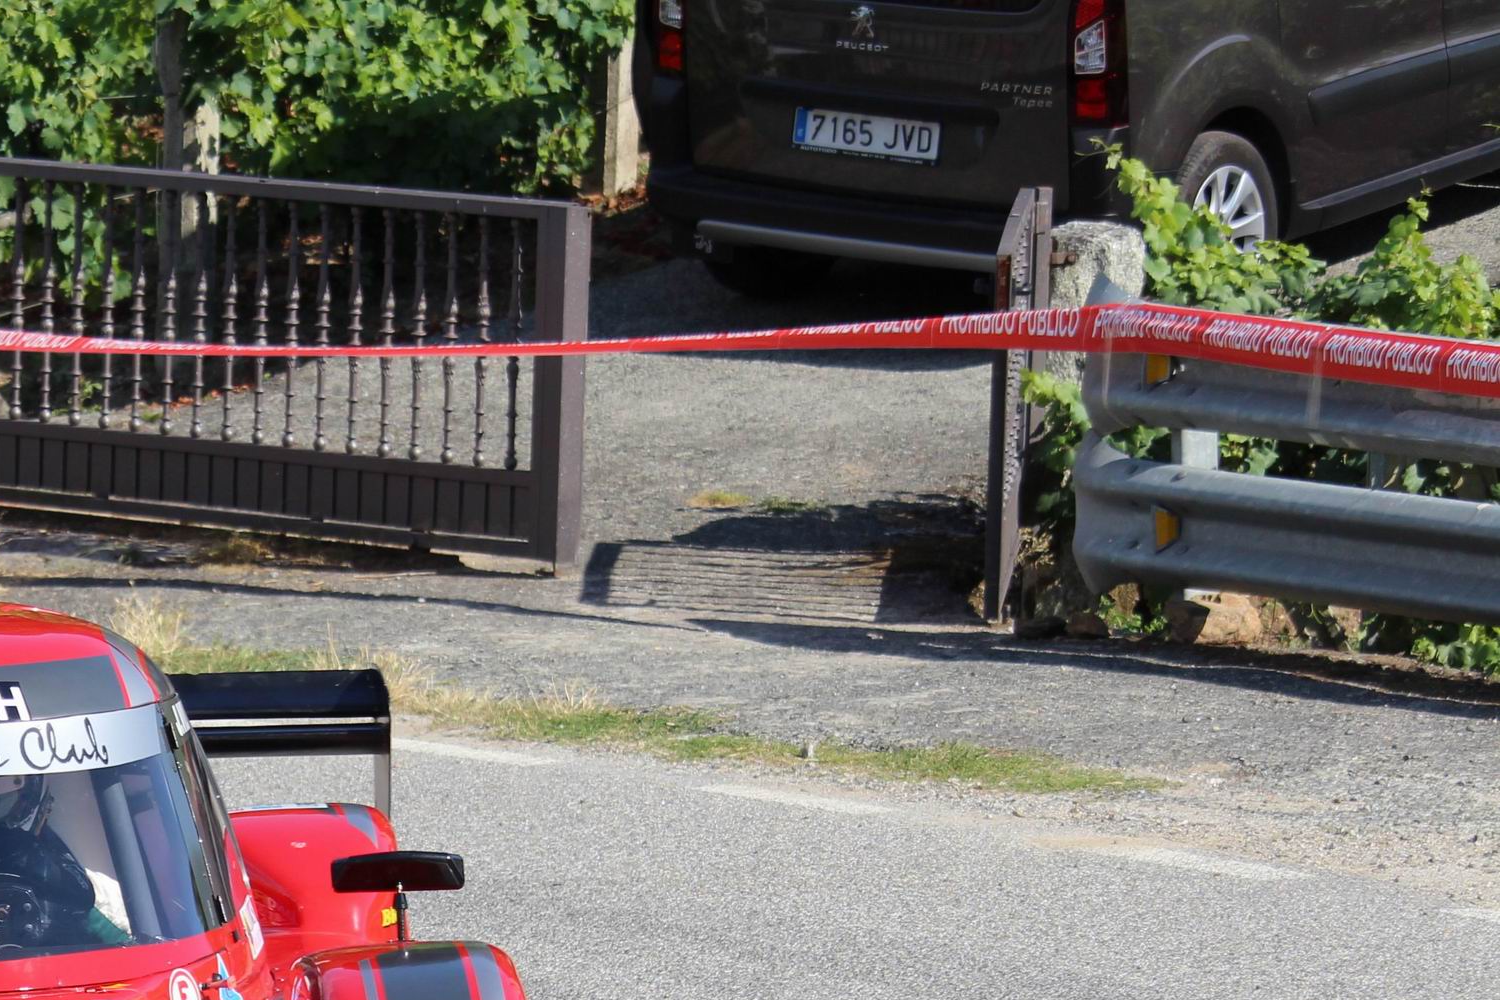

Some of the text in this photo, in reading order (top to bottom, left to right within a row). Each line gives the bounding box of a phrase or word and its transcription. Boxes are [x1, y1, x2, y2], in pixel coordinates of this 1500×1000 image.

[836, 40, 890, 52] PEUGEOT
[980, 81, 1054, 96] PARTNER
[1012, 96, 1054, 109] Tepee
[810, 114, 934, 154] 7165 JVD
[1202, 319, 1319, 359] PROHIBIDO PUBLICO
[1323, 333, 1440, 376] PROHIBIDO PUBLICO
[1445, 348, 1500, 384] PROHIBID
[19, 717, 110, 772] Club
